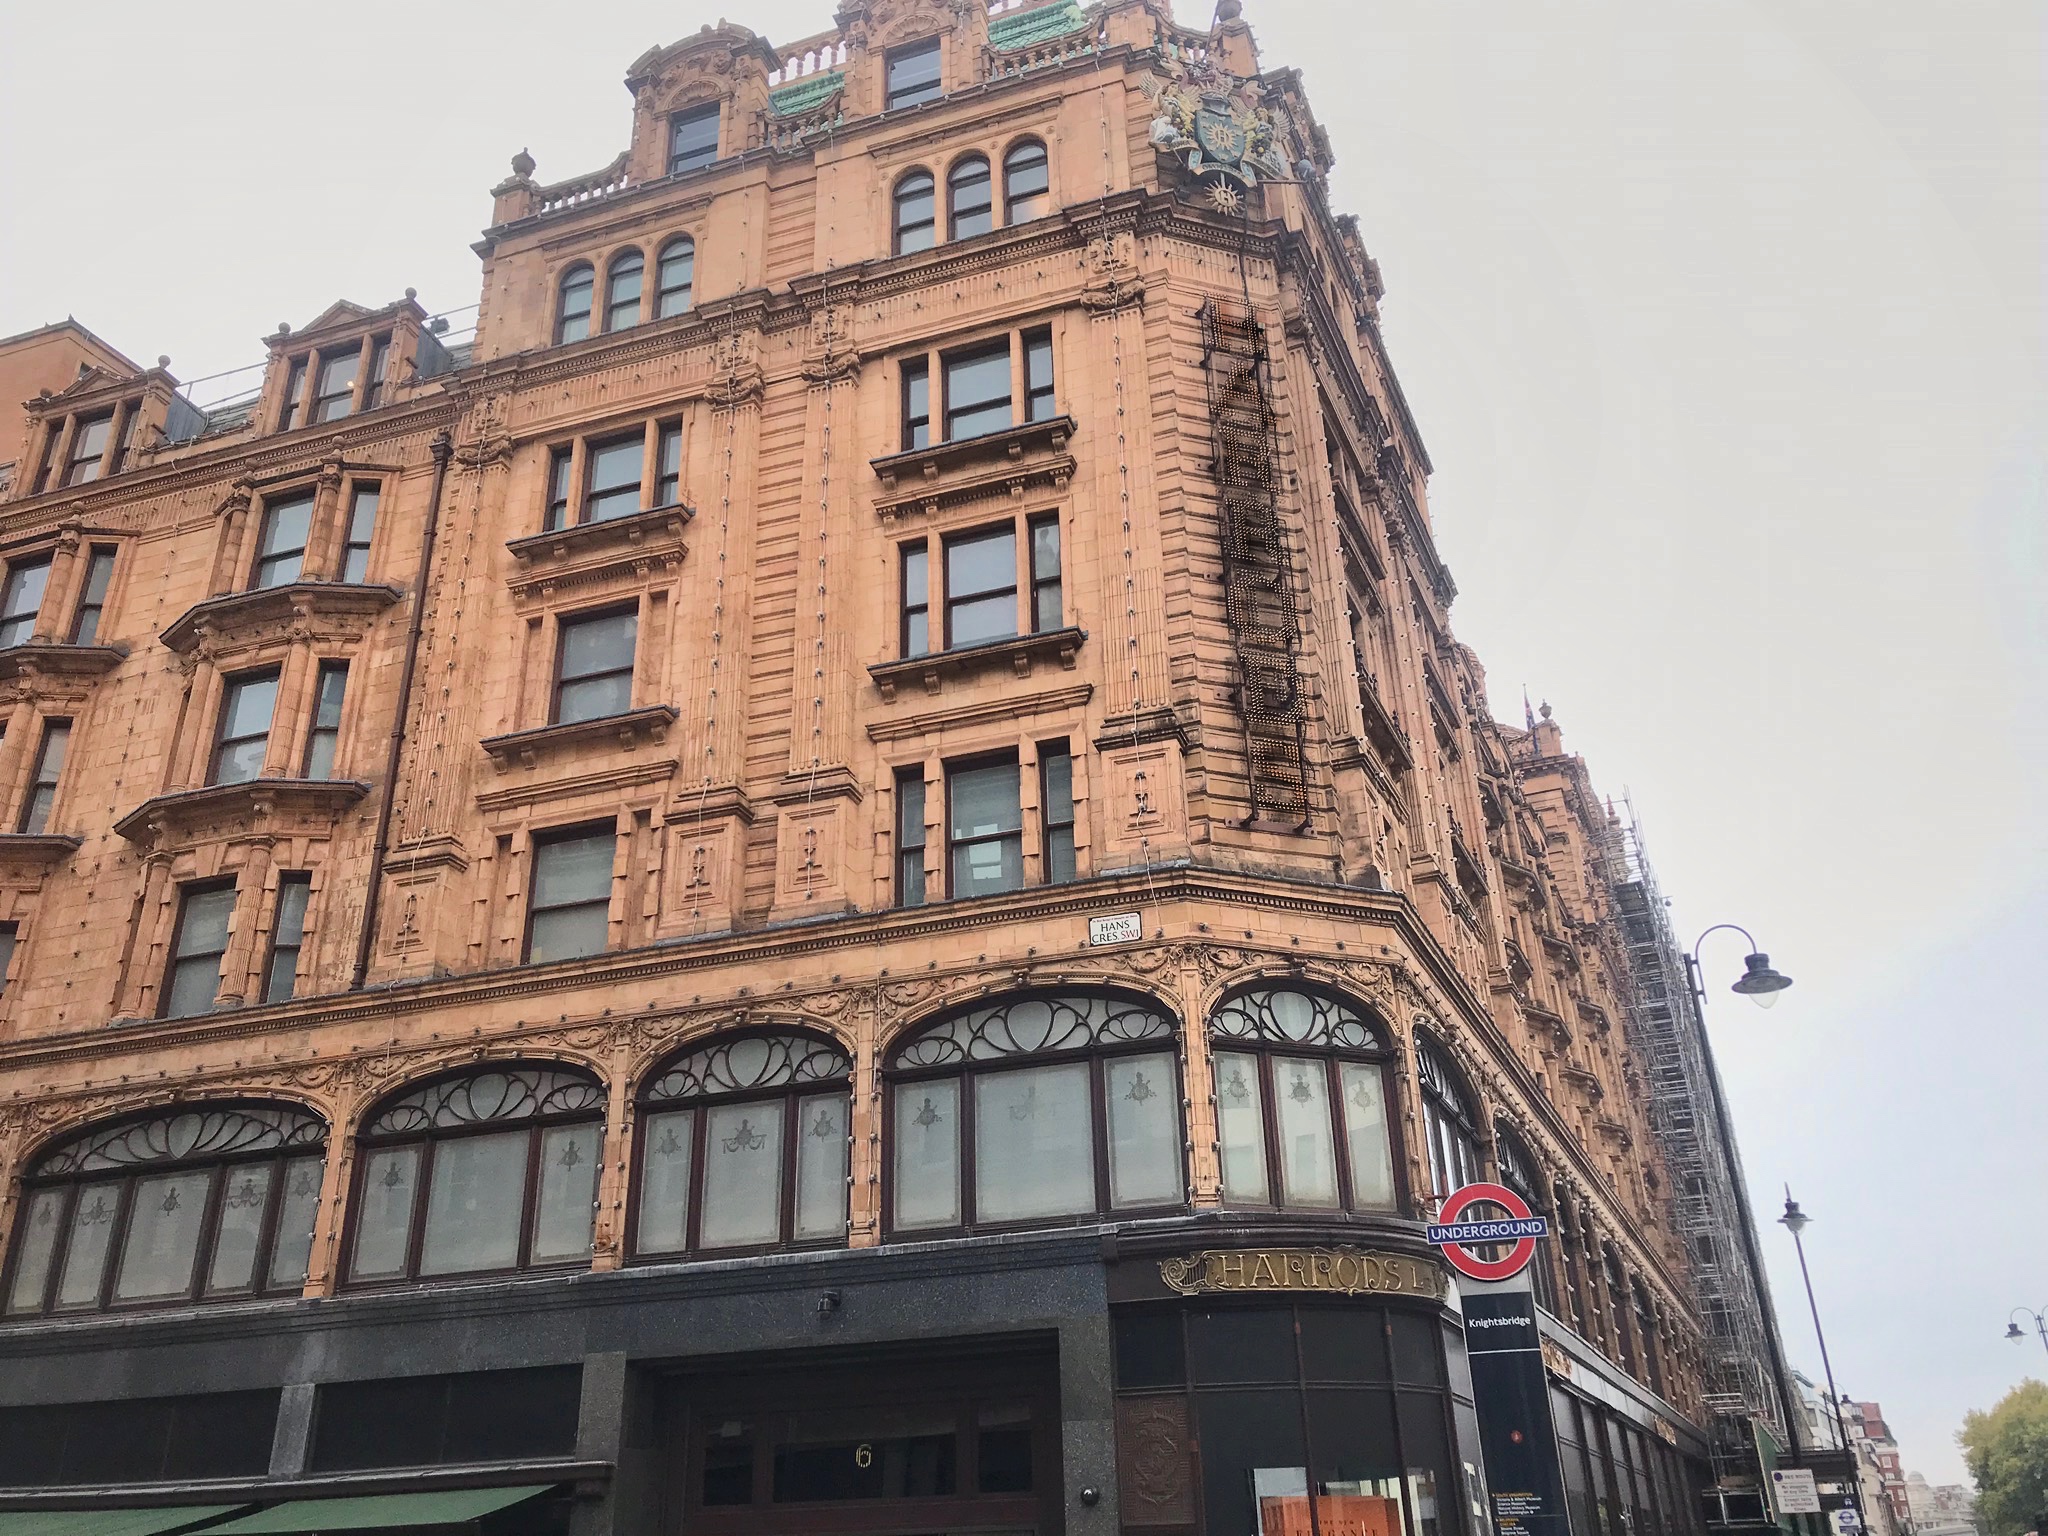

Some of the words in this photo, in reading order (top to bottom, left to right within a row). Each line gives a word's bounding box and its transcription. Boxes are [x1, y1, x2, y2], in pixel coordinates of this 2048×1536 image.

[1203, 292, 1308, 811] HARRODS
[1100, 920, 1130, 932] HANS
[1431, 1221, 1543, 1241] UNDERGROUND
[1215, 1253, 1403, 1291] HARRODS
[1468, 1316, 1531, 1329] Knightsbridge
[855, 1443, 872, 1469] 6
